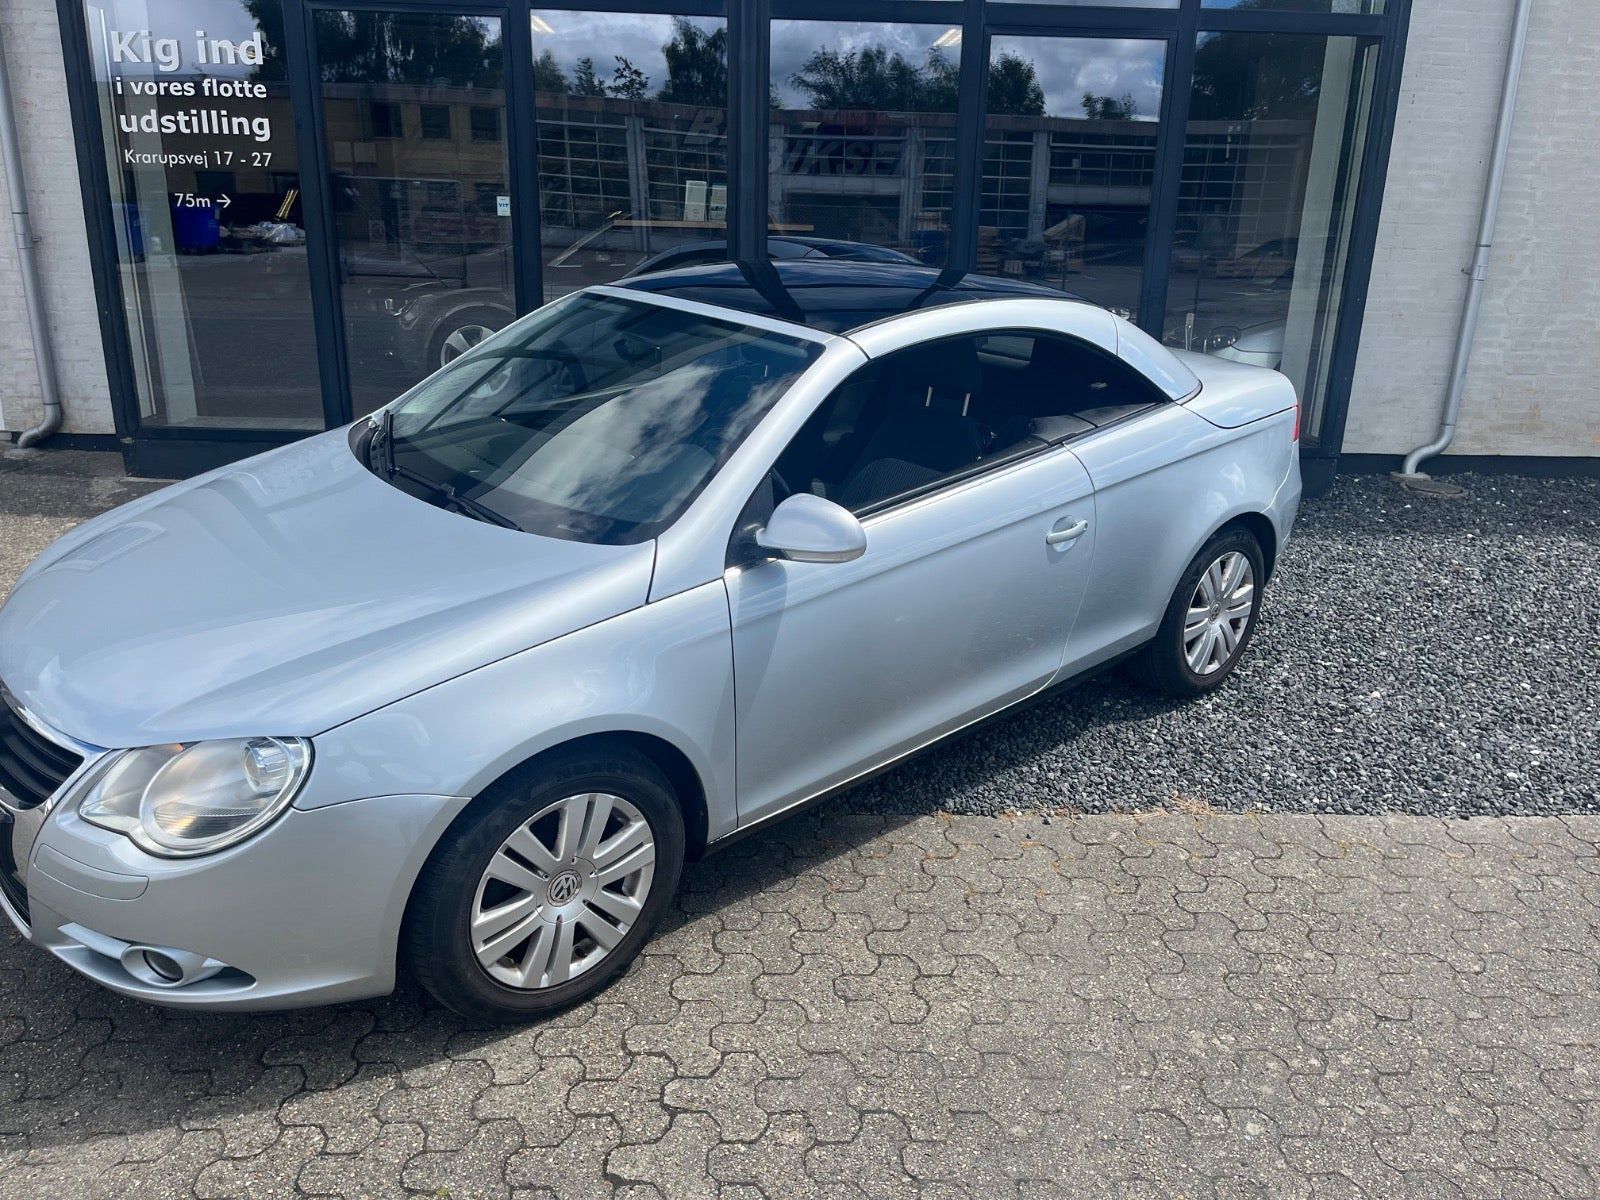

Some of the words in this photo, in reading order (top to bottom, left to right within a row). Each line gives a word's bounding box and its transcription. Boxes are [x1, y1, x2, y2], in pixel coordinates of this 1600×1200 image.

[110, 30, 180, 71] Kig
[195, 31, 264, 65] ind
[116, 77, 122, 95] i
[130, 80, 195, 96] vores
[202, 78, 267, 98] flotte
[119, 109, 271, 141] udstilling
[124, 149, 209, 168] Krarupsvej
[214, 151, 233, 166] 17
[252, 152, 272, 167] 27
[174, 193, 211, 207] 75m
